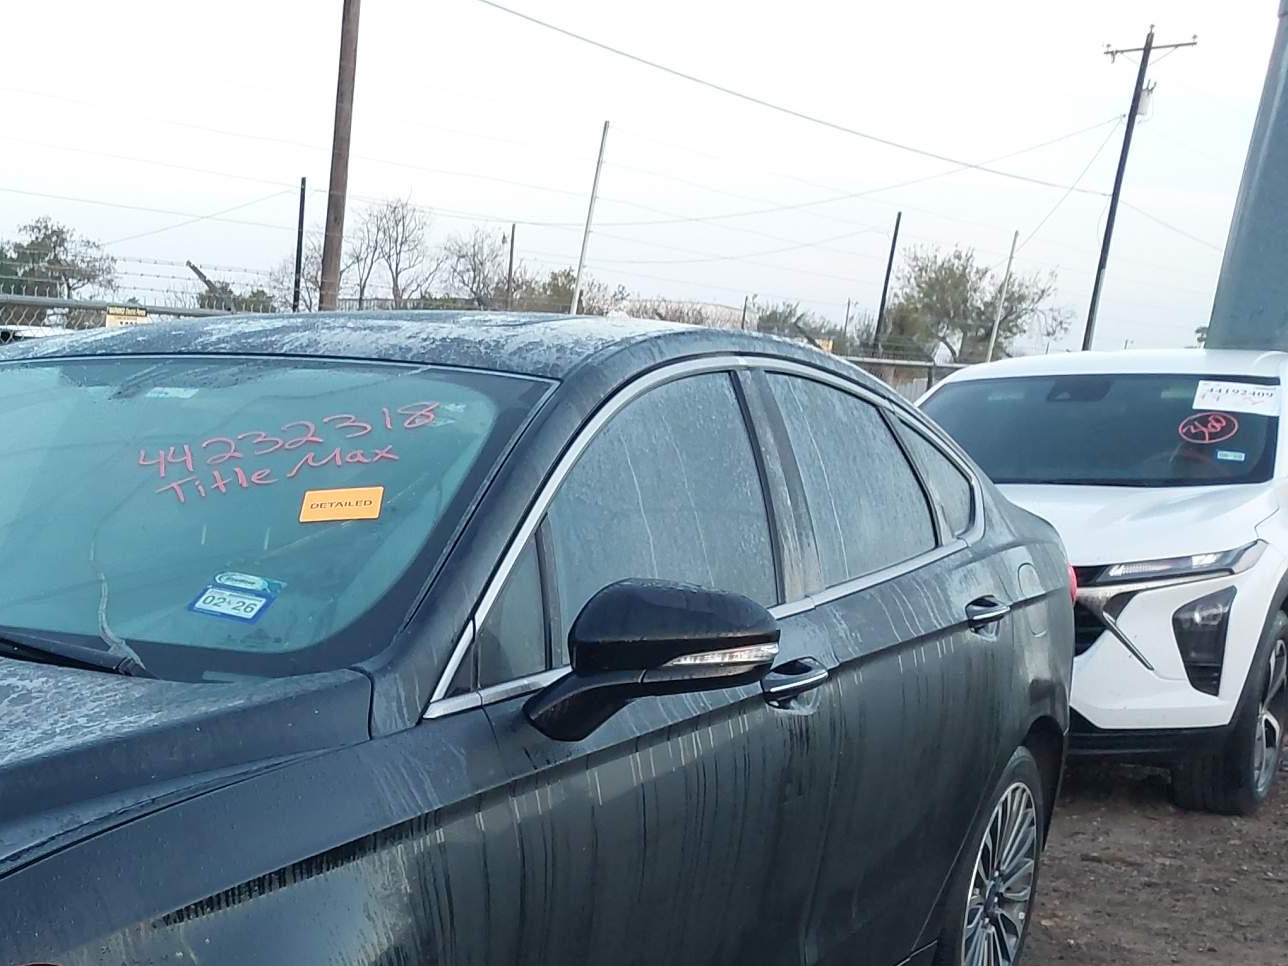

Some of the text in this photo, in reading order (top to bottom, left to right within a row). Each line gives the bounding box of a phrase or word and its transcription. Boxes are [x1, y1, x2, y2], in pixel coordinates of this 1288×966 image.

[138, 401, 441, 478] 44232318
[155, 444, 400, 502] Title Max
[309, 499, 374, 510] DETAILED
[202, 595, 227, 608] 02
[232, 600, 258, 614] 26
